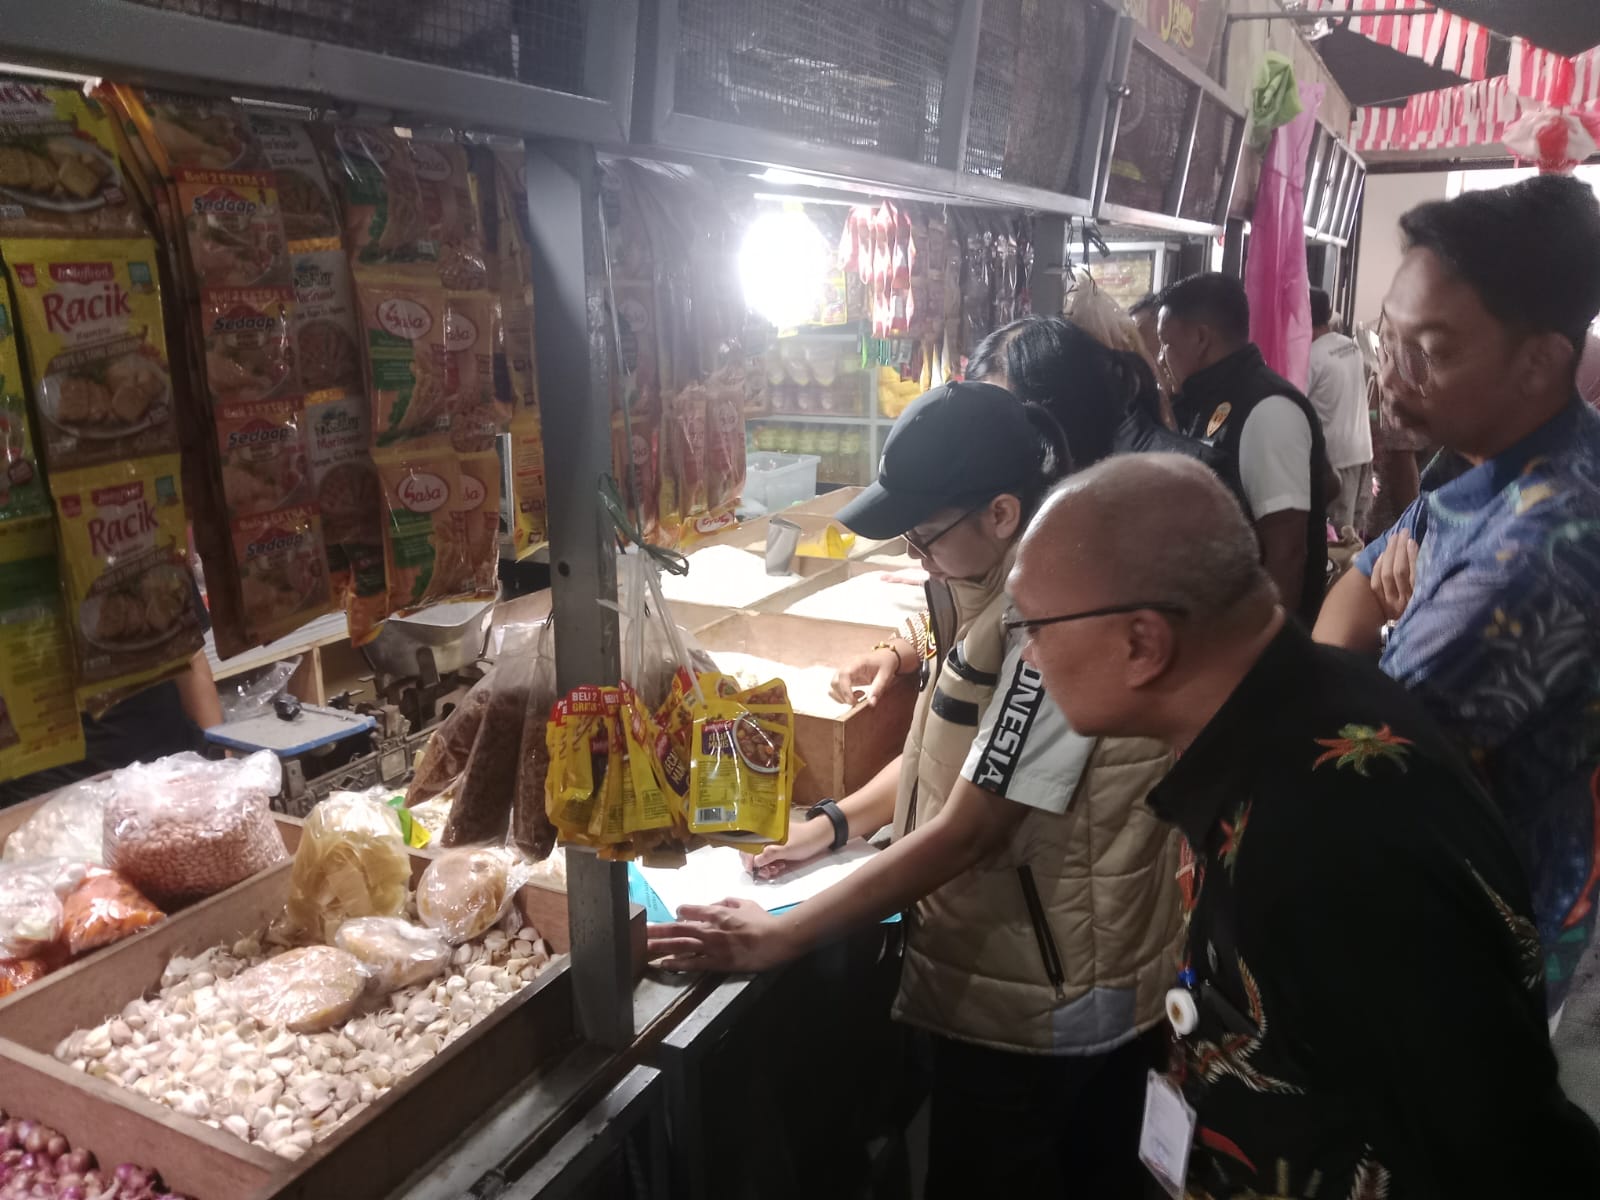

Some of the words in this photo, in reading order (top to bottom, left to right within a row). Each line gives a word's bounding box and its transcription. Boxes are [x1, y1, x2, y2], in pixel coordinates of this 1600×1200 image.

[193, 195, 257, 215] Sedaap
[42, 283, 131, 332] Racik
[214, 316, 275, 334] Sedaap
[228, 428, 289, 447] Sedaap
[88, 499, 160, 557] Racik
[247, 534, 304, 556] Sedaap
[572, 692, 591, 702] BELI
